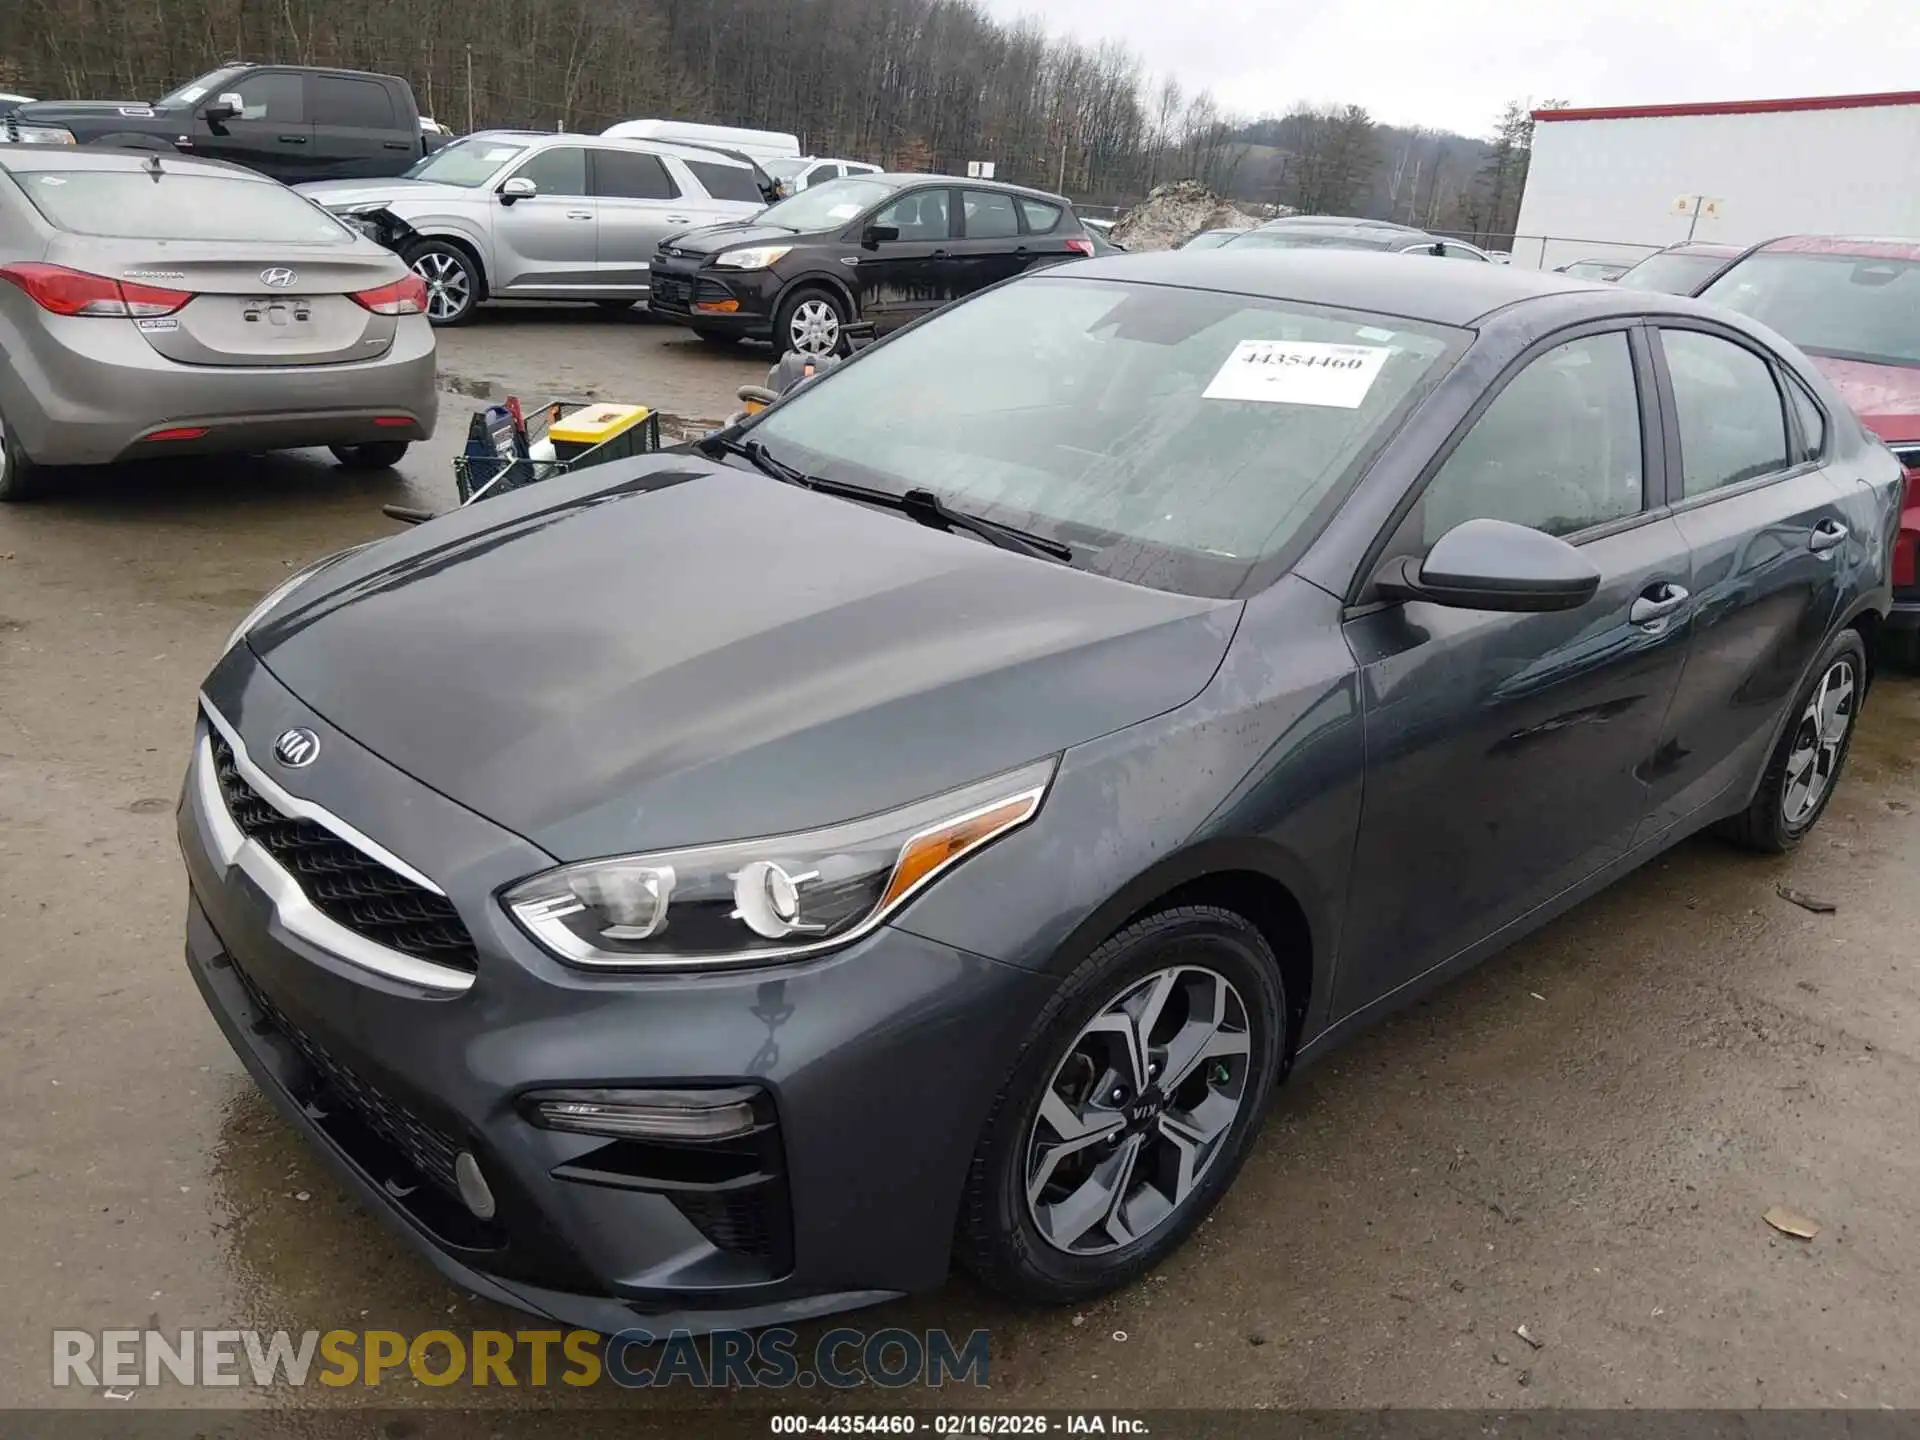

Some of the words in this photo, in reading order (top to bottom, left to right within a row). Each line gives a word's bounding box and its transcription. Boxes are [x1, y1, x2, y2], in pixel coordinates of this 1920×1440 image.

[1242, 353, 1363, 370] 44354460
[280, 730, 311, 763] KIA
[1133, 1104, 1157, 1120] KIA
